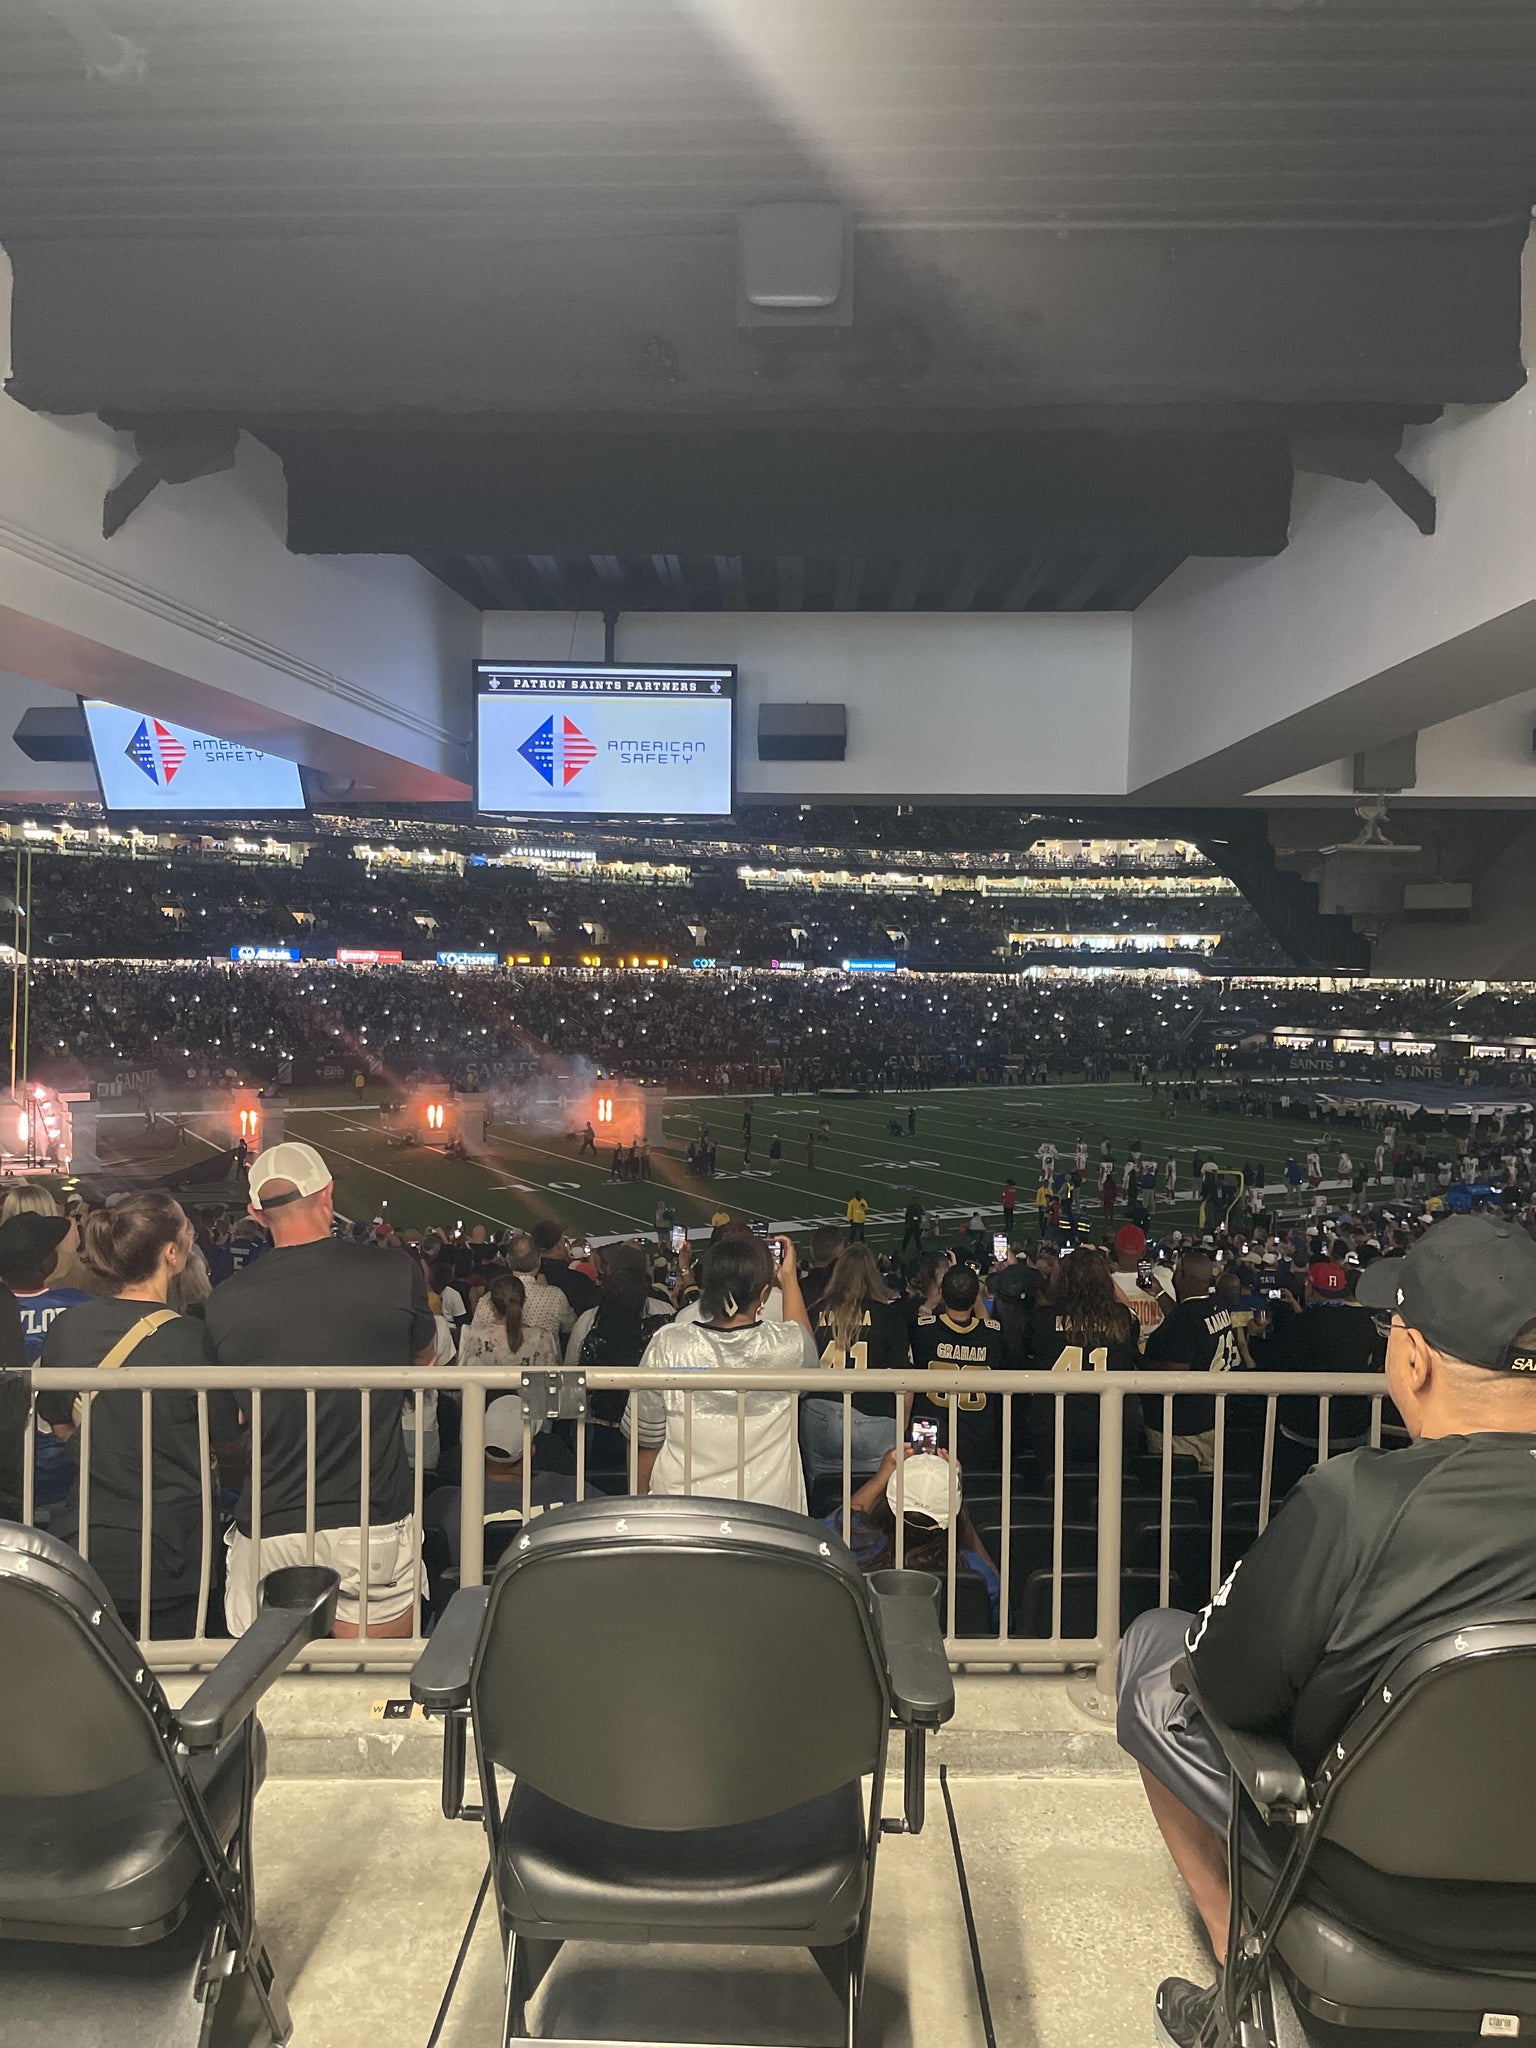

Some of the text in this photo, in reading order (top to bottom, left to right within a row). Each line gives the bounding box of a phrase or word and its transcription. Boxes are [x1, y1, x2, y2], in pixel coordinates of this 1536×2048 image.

[513, 679, 697, 692] PATRON SAINTS PARTNERS
[193, 739, 250, 750] AMER
[608, 740, 706, 752] AMERICAN
[205, 752, 264, 762] SAFETY
[621, 753, 693, 764] SAFETY
[446, 953, 496, 965] Ochsner
[693, 958, 716, 968] COX
[1290, 1057, 1334, 1072] SAINTS
[820, 1340, 868, 1369] 41
[936, 1342, 987, 1361] GRAHAM
[1052, 1346, 1107, 1371] 41
[1511, 1358, 1536, 1371] SA
[914, 1501, 930, 1510] POLO
[393, 1705, 406, 1713] 16
